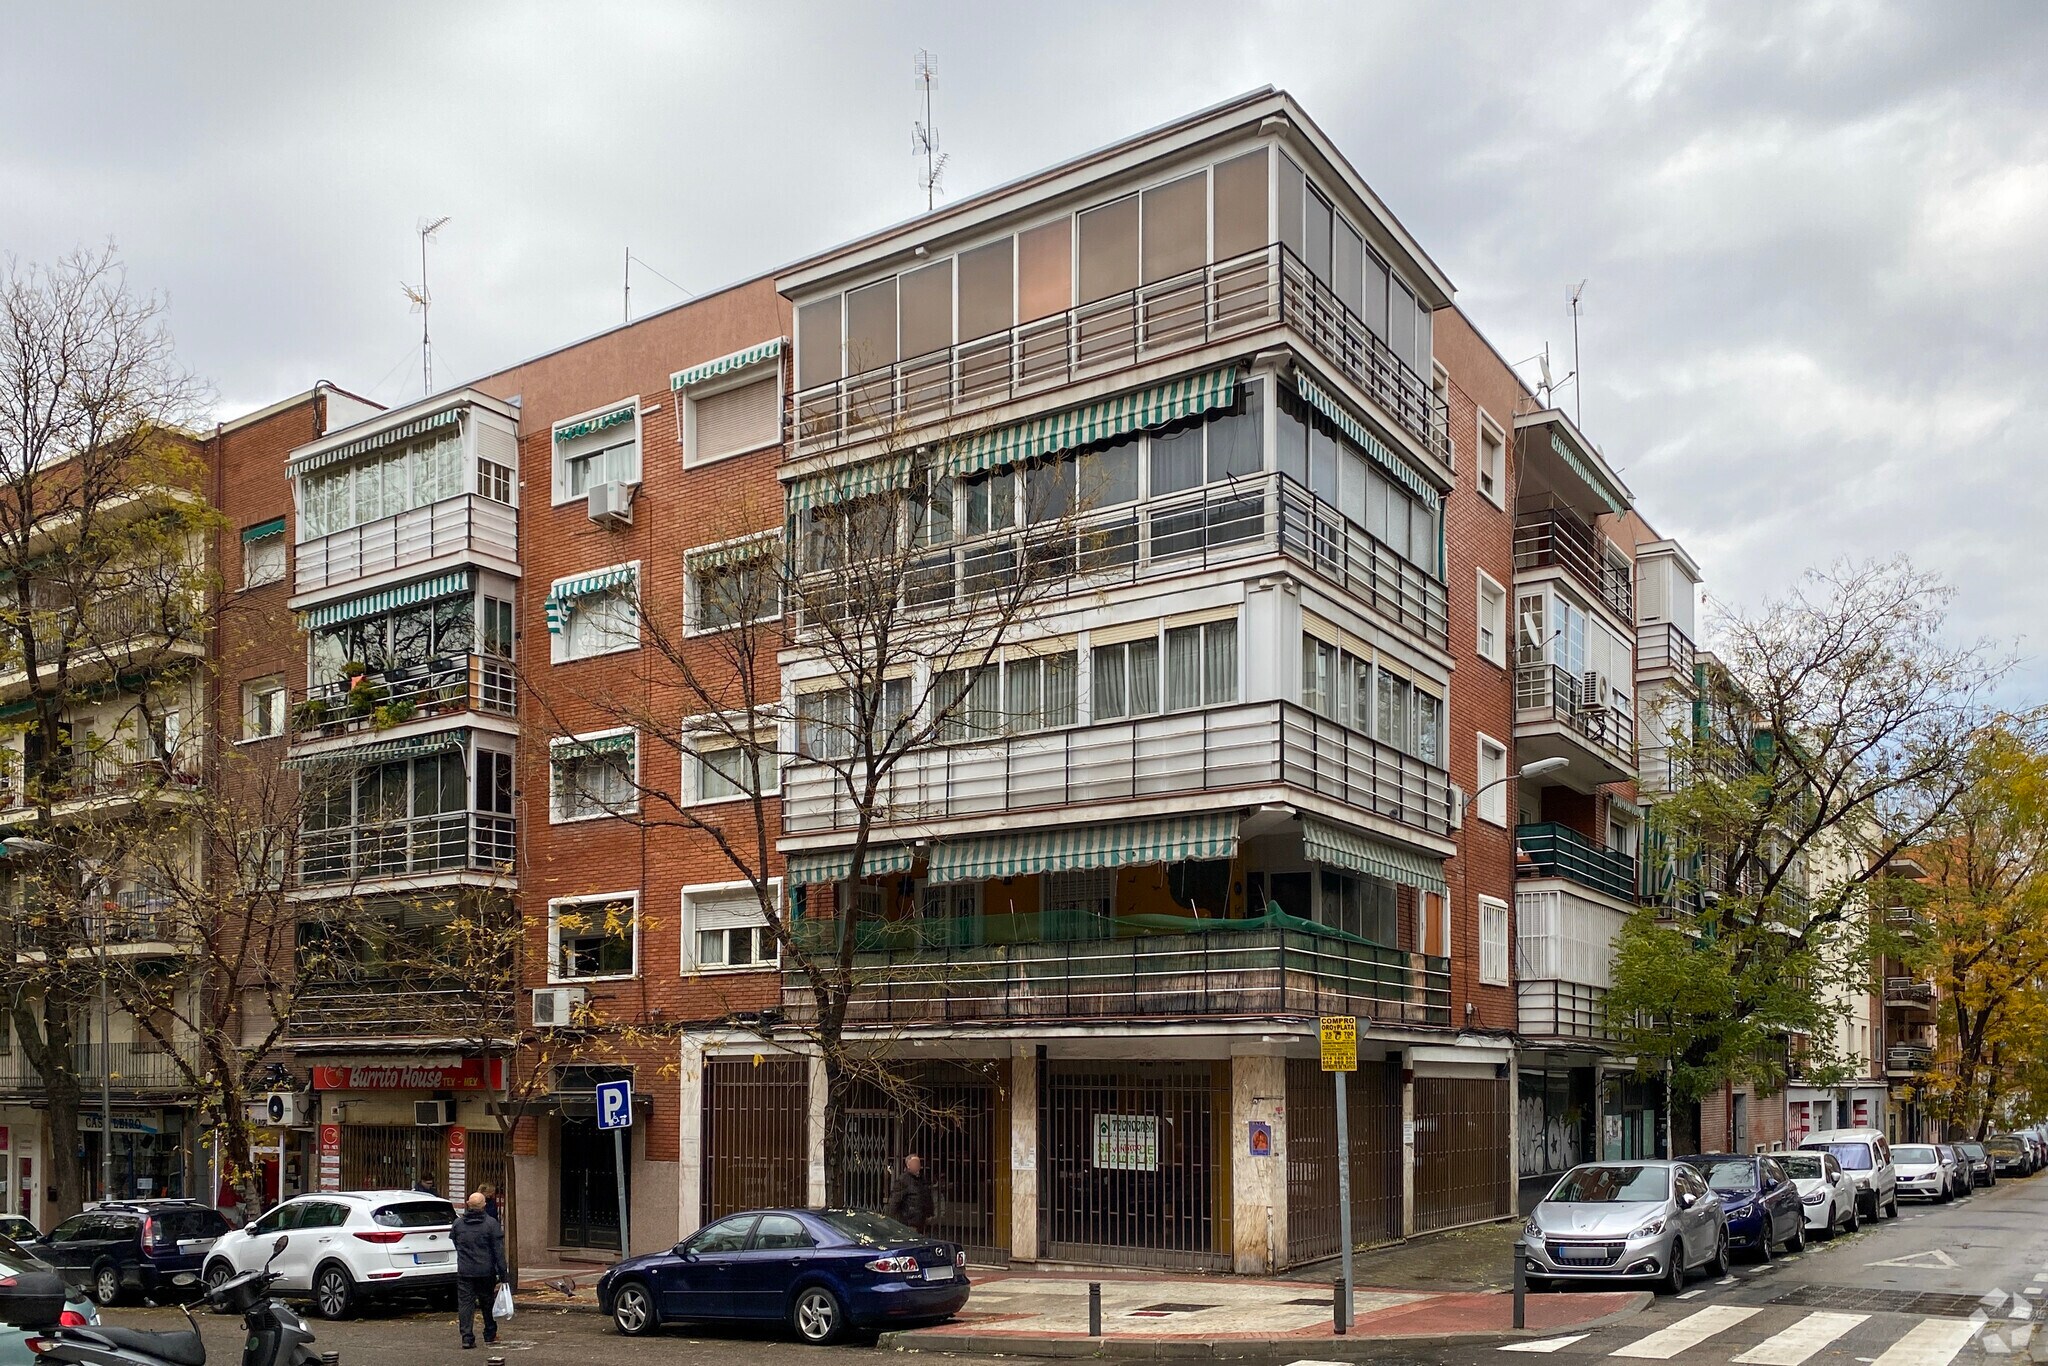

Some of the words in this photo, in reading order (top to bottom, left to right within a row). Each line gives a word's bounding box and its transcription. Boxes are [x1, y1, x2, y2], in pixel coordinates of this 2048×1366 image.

[349, 1067, 398, 1088] Burrito
[400, 1066, 443, 1088] House
[603, 1088, 623, 1123] P
